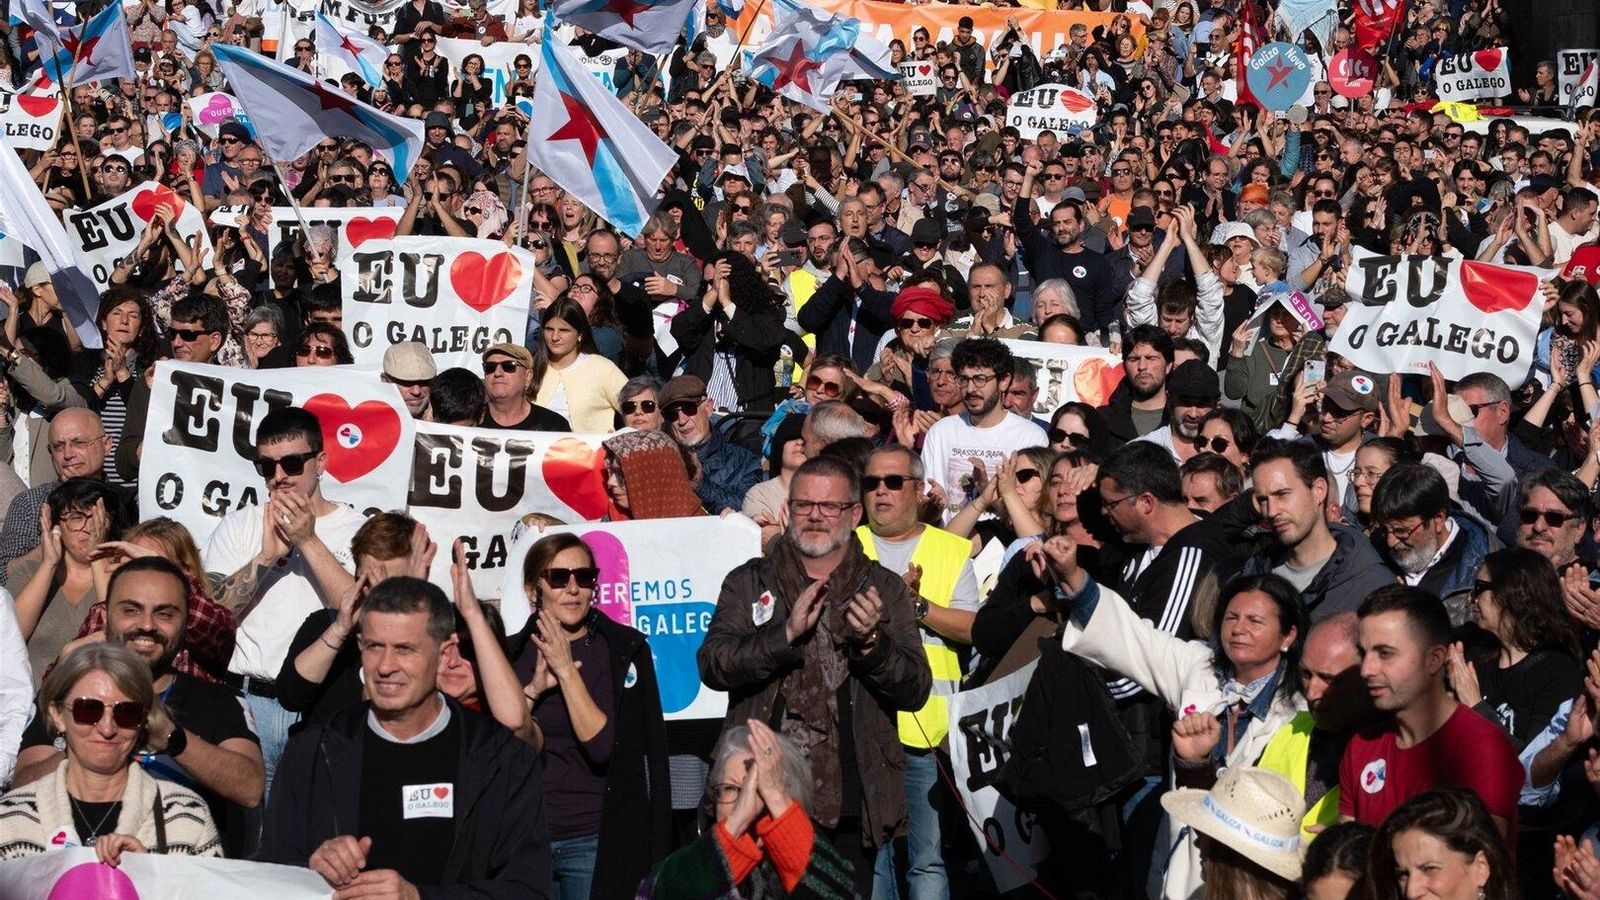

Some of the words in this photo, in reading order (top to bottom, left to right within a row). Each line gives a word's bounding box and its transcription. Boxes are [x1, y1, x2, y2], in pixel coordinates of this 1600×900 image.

[1339, 58, 1369, 77] CIG
[1440, 53, 1472, 76] EU
[1014, 88, 1059, 109] EU
[1443, 83, 1451, 94] O
[1456, 77, 1505, 91] GALEGO
[1013, 115, 1022, 127] O
[70, 202, 135, 252] EU
[92, 264, 108, 284] O
[353, 250, 445, 308] EU
[1359, 255, 1454, 308] EU
[353, 321, 373, 348] O
[387, 321, 513, 354] GALEGO
[1348, 325, 1368, 349] O
[1376, 317, 1519, 364] GALEGO
[162, 370, 293, 461] EU
[407, 432, 535, 512] EU
[156, 472, 184, 511] O
[409, 789, 431, 801] EU
[983, 817, 1005, 856] O
